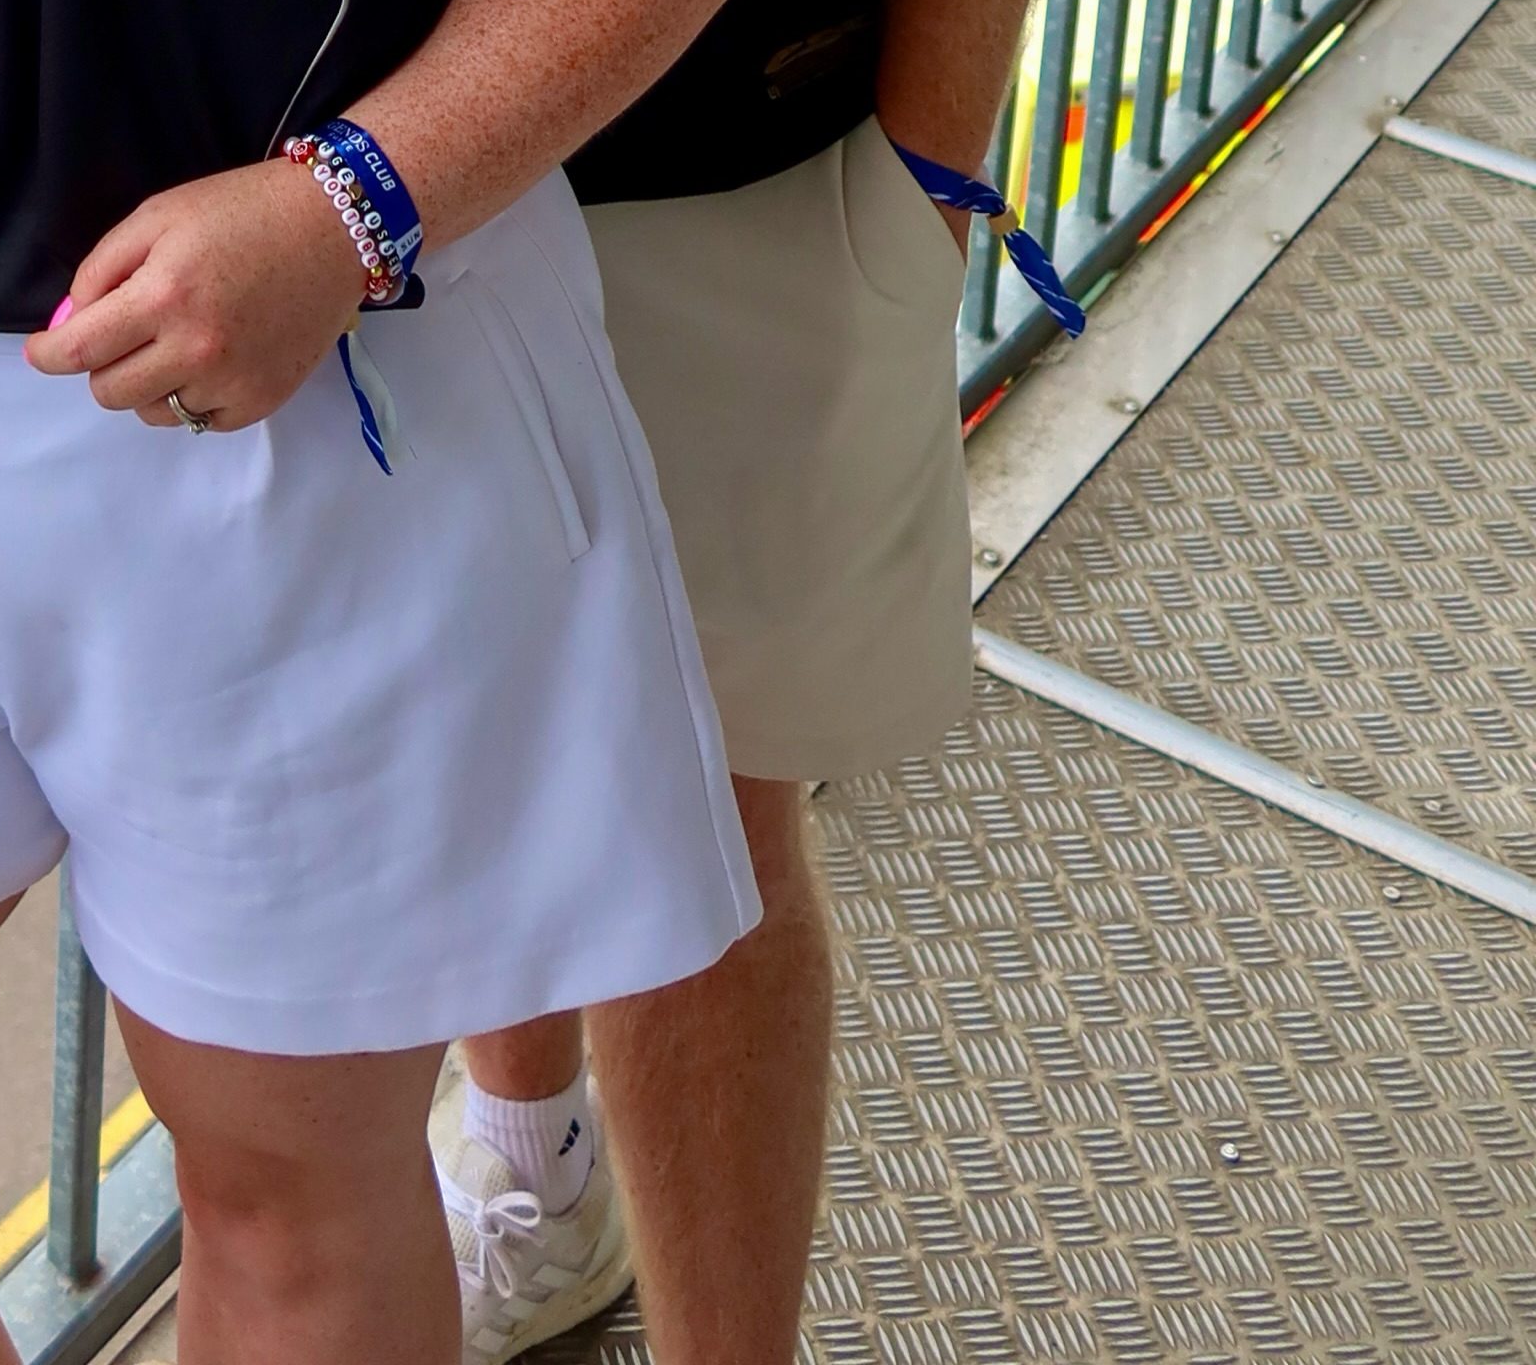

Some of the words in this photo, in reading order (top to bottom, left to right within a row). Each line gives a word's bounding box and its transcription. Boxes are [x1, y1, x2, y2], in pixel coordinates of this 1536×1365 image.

[364, 151, 397, 191] CLUB
[317, 166, 378, 267] YOUTUBE
[400, 230, 421, 253] SUN
